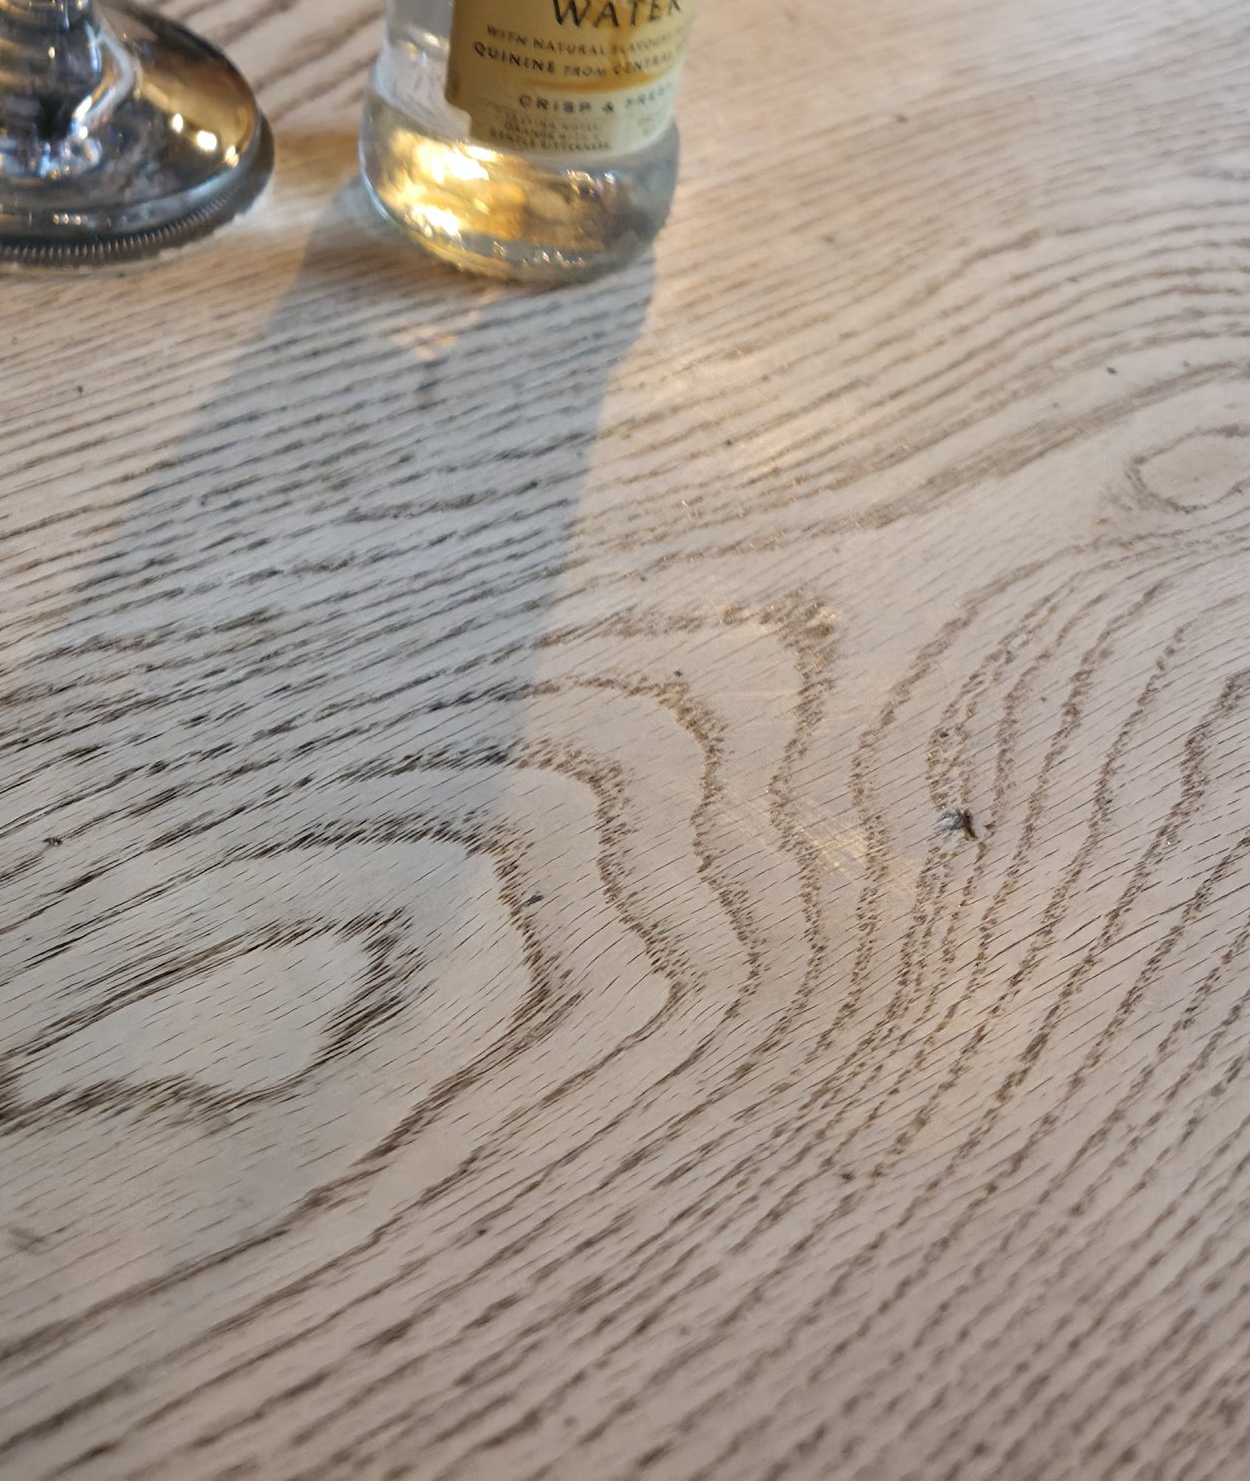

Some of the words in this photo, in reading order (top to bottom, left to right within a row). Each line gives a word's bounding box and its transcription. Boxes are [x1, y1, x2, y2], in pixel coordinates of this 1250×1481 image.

[534, 39, 606, 56] NATURAL
[472, 40, 555, 75] QUININE
[564, 63, 607, 78] FROM
[519, 94, 592, 114] CRISP
